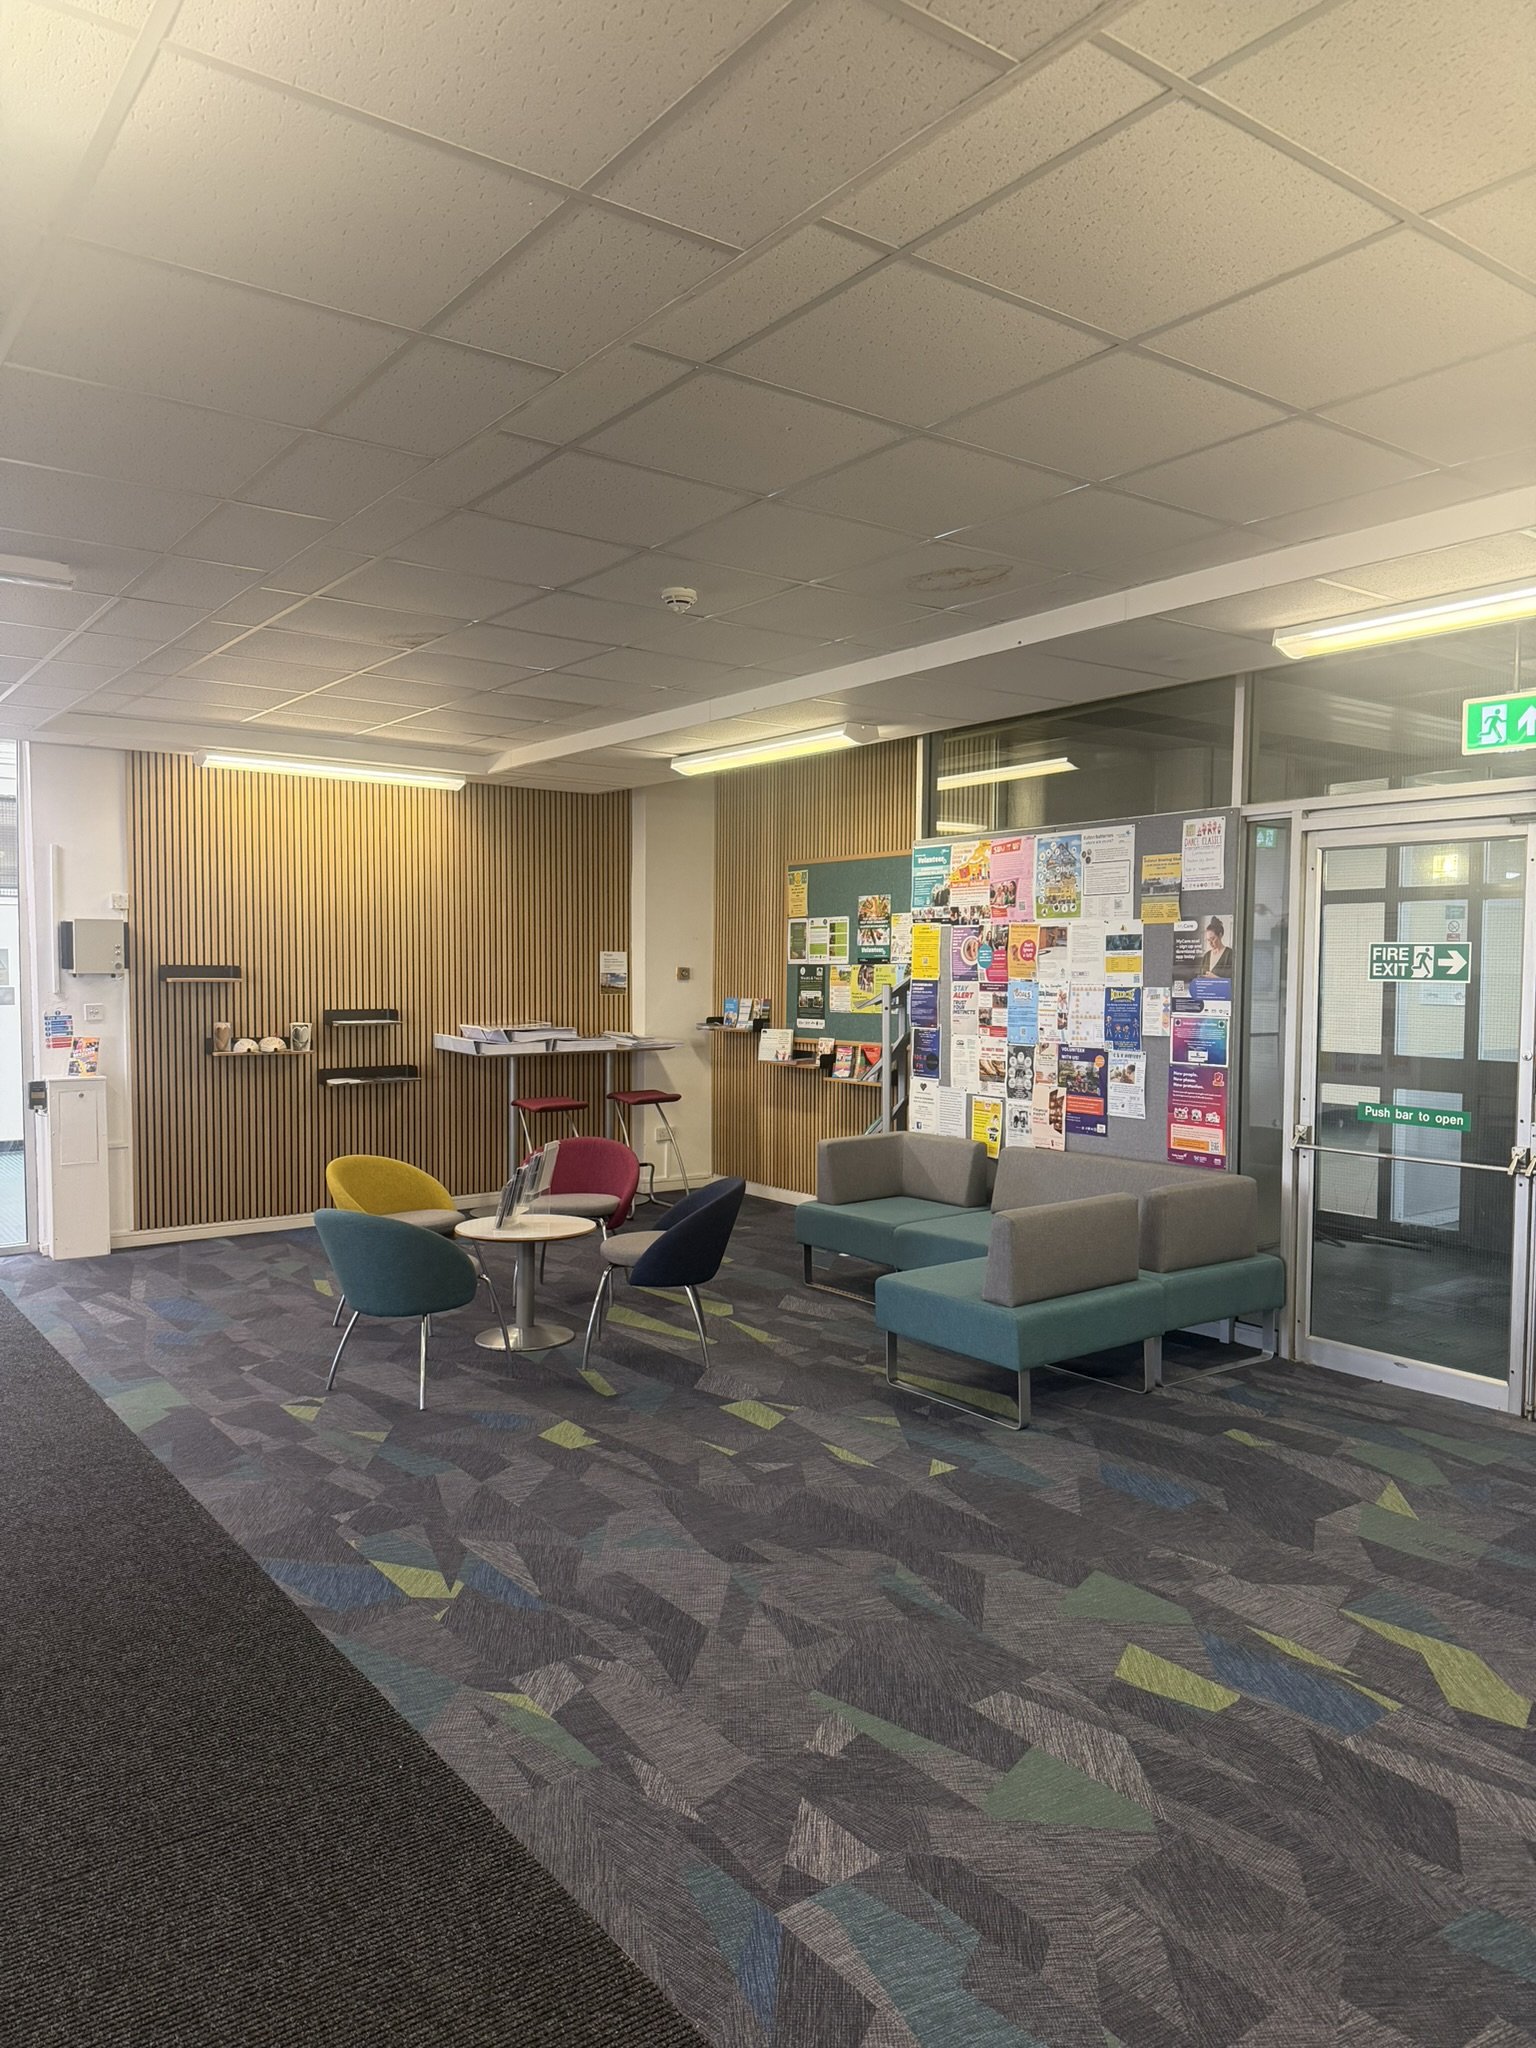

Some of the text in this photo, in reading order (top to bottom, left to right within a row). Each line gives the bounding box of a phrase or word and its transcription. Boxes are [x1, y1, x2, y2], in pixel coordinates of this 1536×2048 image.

[1184, 836, 1223, 846] DANCE CLASSES
[917, 856, 944, 865] Volunteer
[1372, 947, 1410, 961] FIRE
[1372, 963, 1410, 977] EXIT
[1364, 1105, 1464, 1126] Push bar to open
